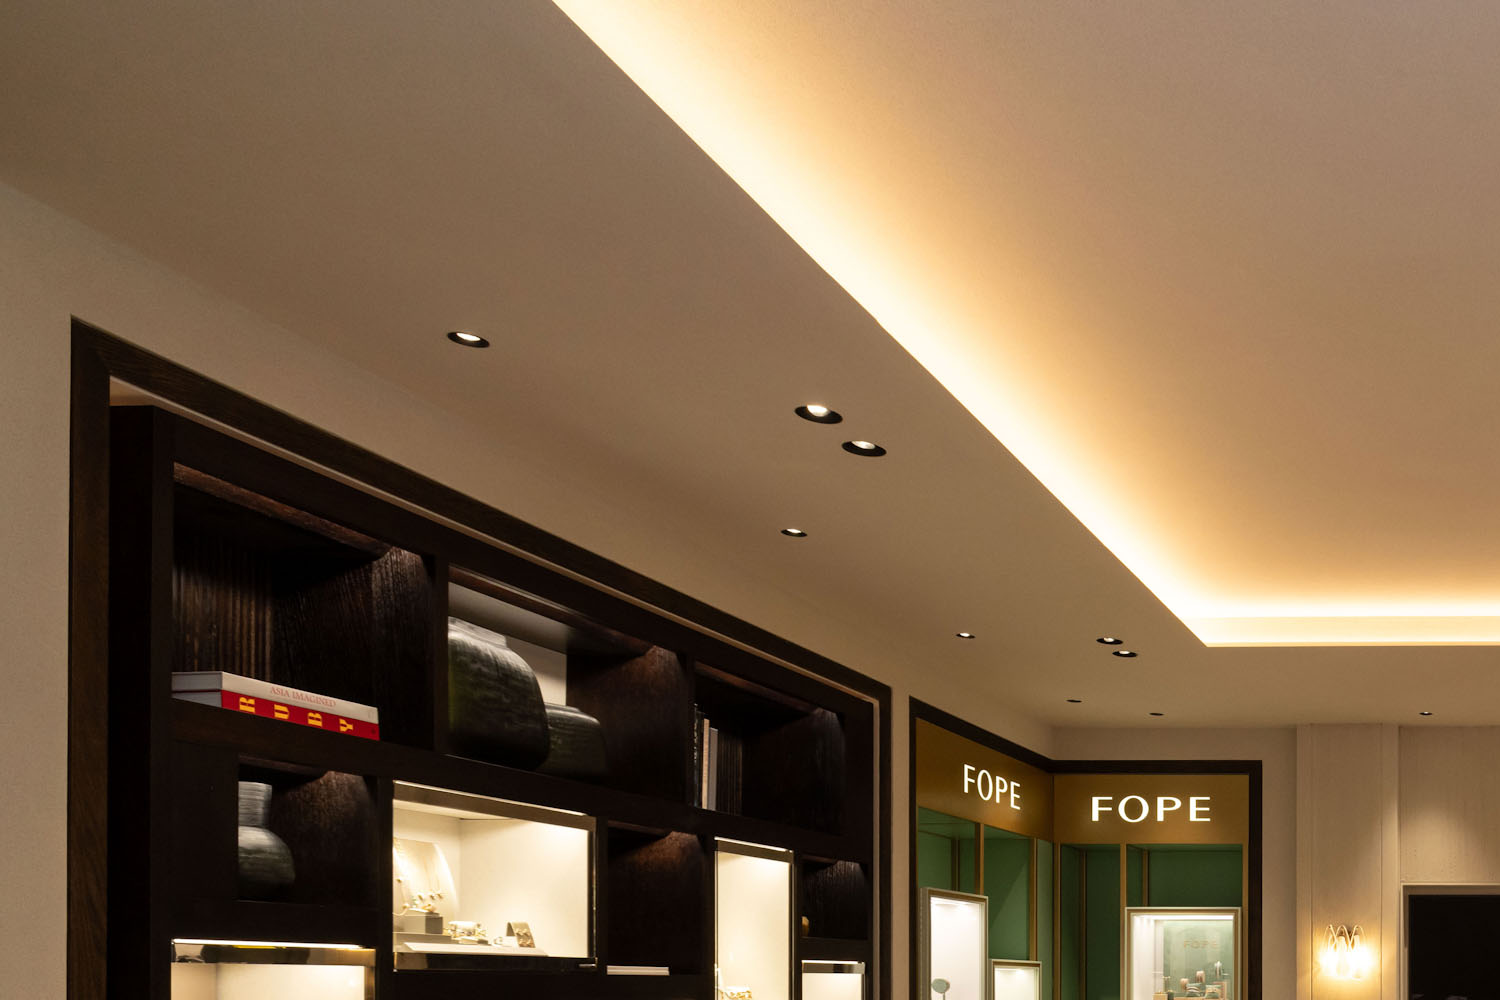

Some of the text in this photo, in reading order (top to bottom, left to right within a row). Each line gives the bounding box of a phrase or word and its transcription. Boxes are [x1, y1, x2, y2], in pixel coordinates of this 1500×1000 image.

[271, 686, 337, 708] ASIA IMAGINED
[239, 696, 354, 732] RUBY
[963, 763, 1021, 811] FOPE
[1091, 795, 1211, 823] FOPE
